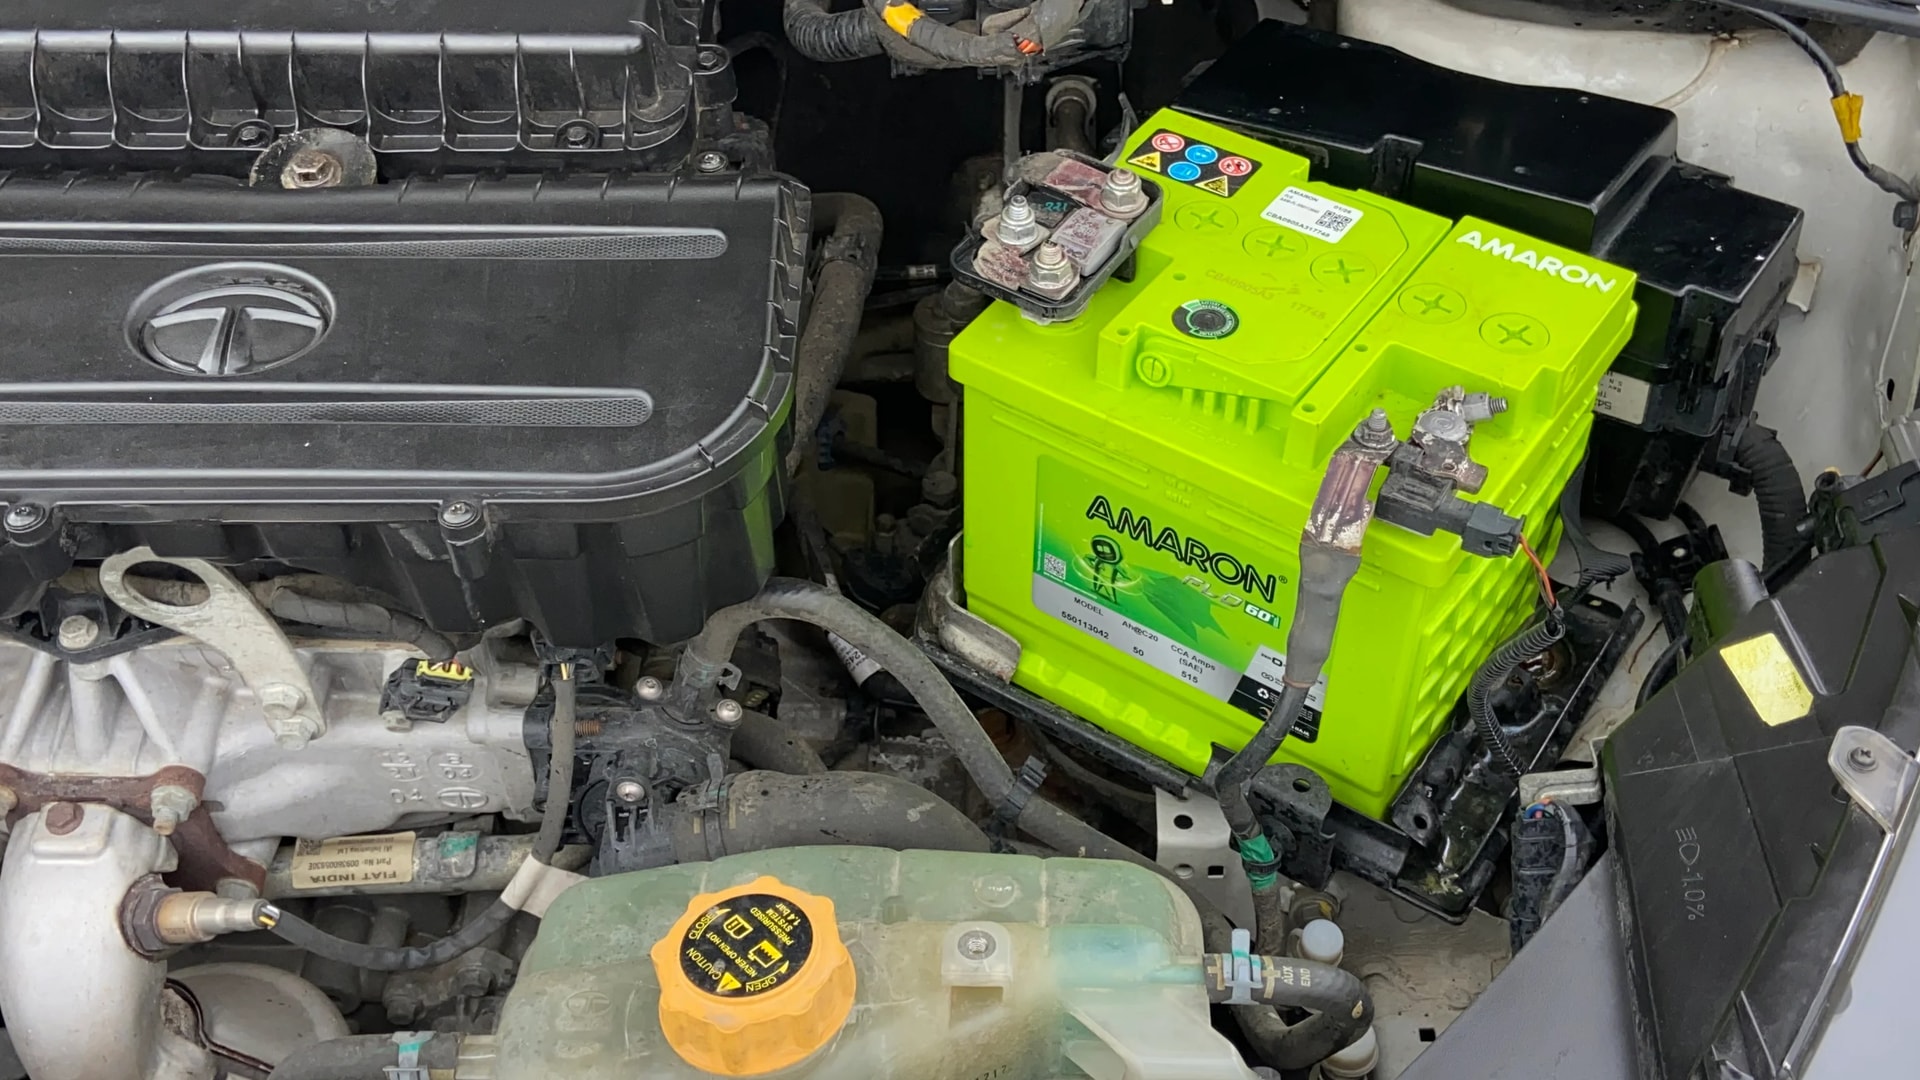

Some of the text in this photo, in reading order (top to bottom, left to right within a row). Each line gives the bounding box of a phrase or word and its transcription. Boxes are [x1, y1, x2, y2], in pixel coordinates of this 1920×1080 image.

[1456, 231, 1617, 293] AMARON
[1073, 597, 1104, 616] MODEL
[1061, 610, 1109, 640] 550113042
[1121, 620, 1159, 642] Ah@C20
[1133, 646, 1144, 657] 50
[1170, 644, 1216, 672] CCA Amps
[1179, 657, 1203, 674] (SAE)
[1181, 670, 1199, 684] 515
[309, 871, 397, 883] FIAT INDIA
[765, 908, 794, 932] SYSTEM
[775, 903, 791, 916] bar
[688, 910, 718, 940] CLOSE
[750, 907, 795, 946] PRESSURISED
[686, 947, 722, 980] CAUTION
[705, 931, 758, 978] NEVER OPEN HOT
[746, 976, 777, 993] OPEN
[1281, 965, 1294, 986] AUX
[1300, 967, 1311, 987] END
